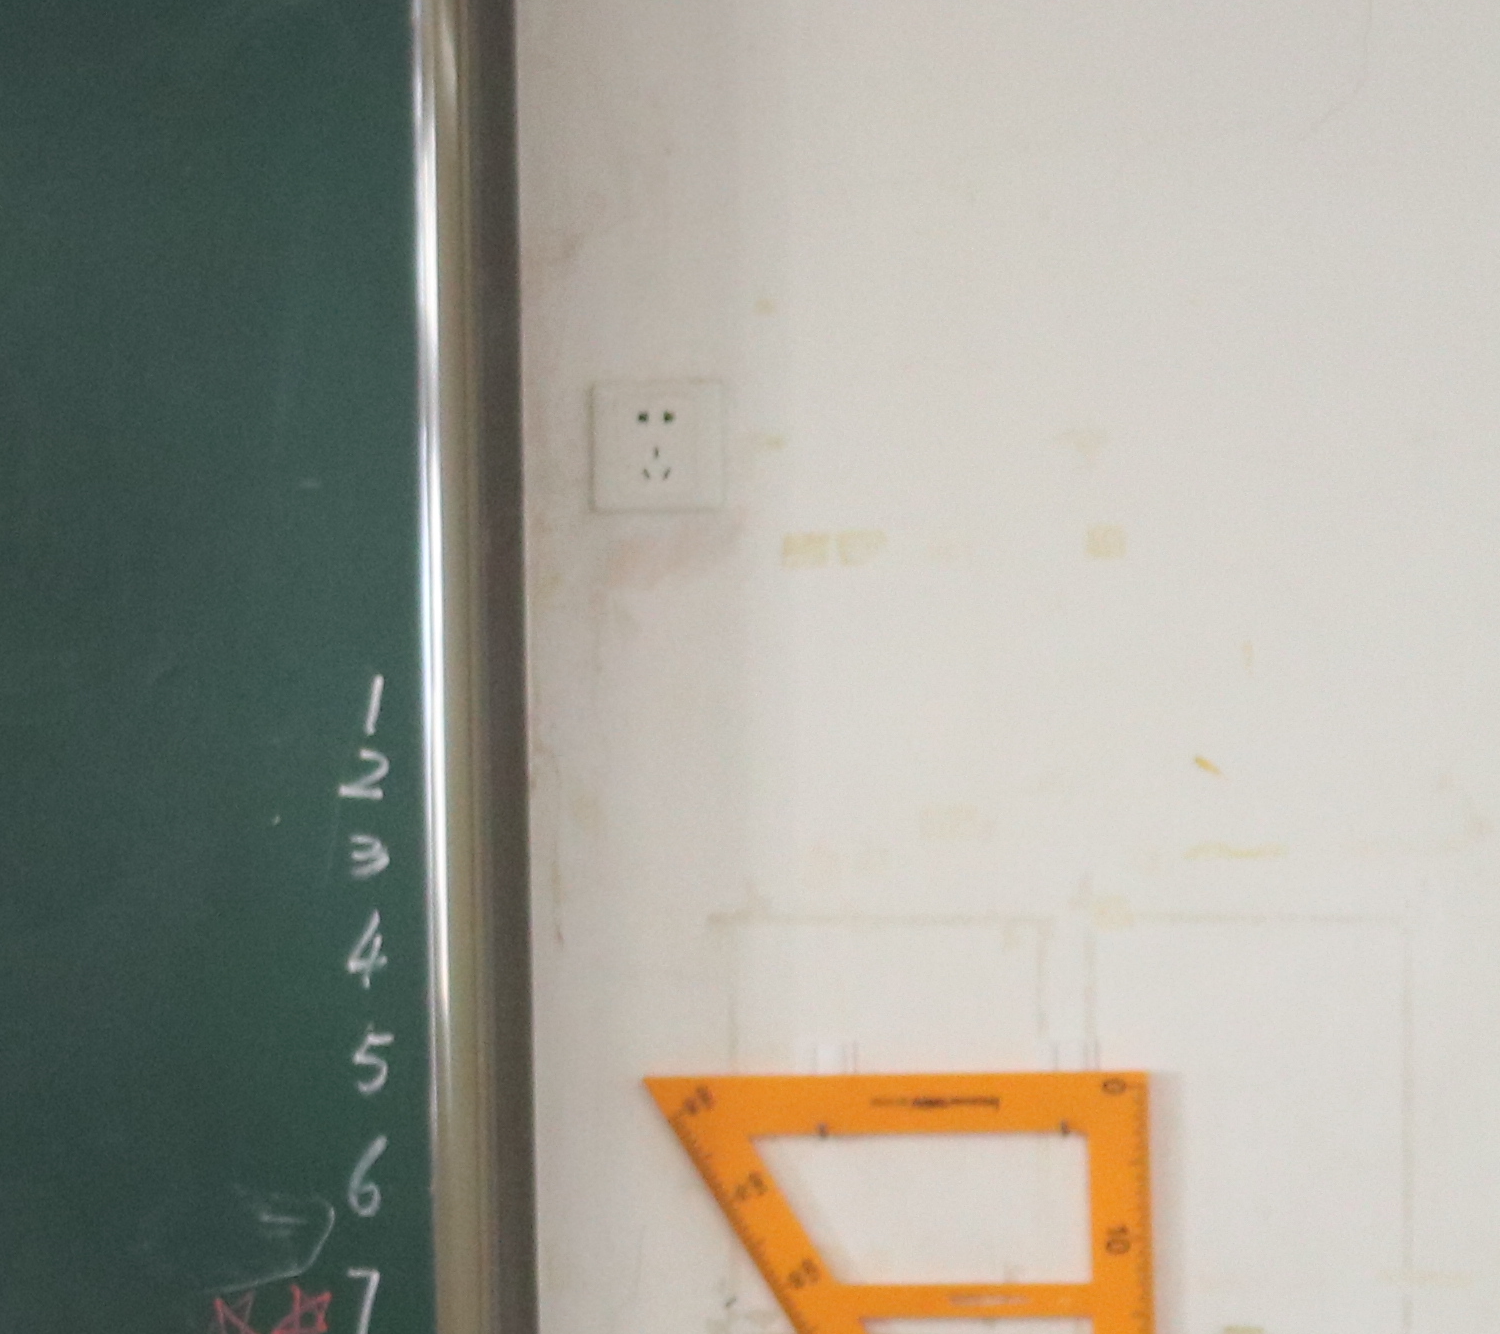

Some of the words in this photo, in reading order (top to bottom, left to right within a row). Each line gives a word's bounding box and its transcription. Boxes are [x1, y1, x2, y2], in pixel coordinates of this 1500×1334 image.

[365, 673, 385, 736] 1
[337, 747, 391, 800] 2
[349, 833, 391, 879] 3
[346, 909, 388, 989] 4
[351, 1028, 395, 1095] 5
[347, 1134, 389, 1218] 6
[1104, 1225, 1132, 1256] 10
